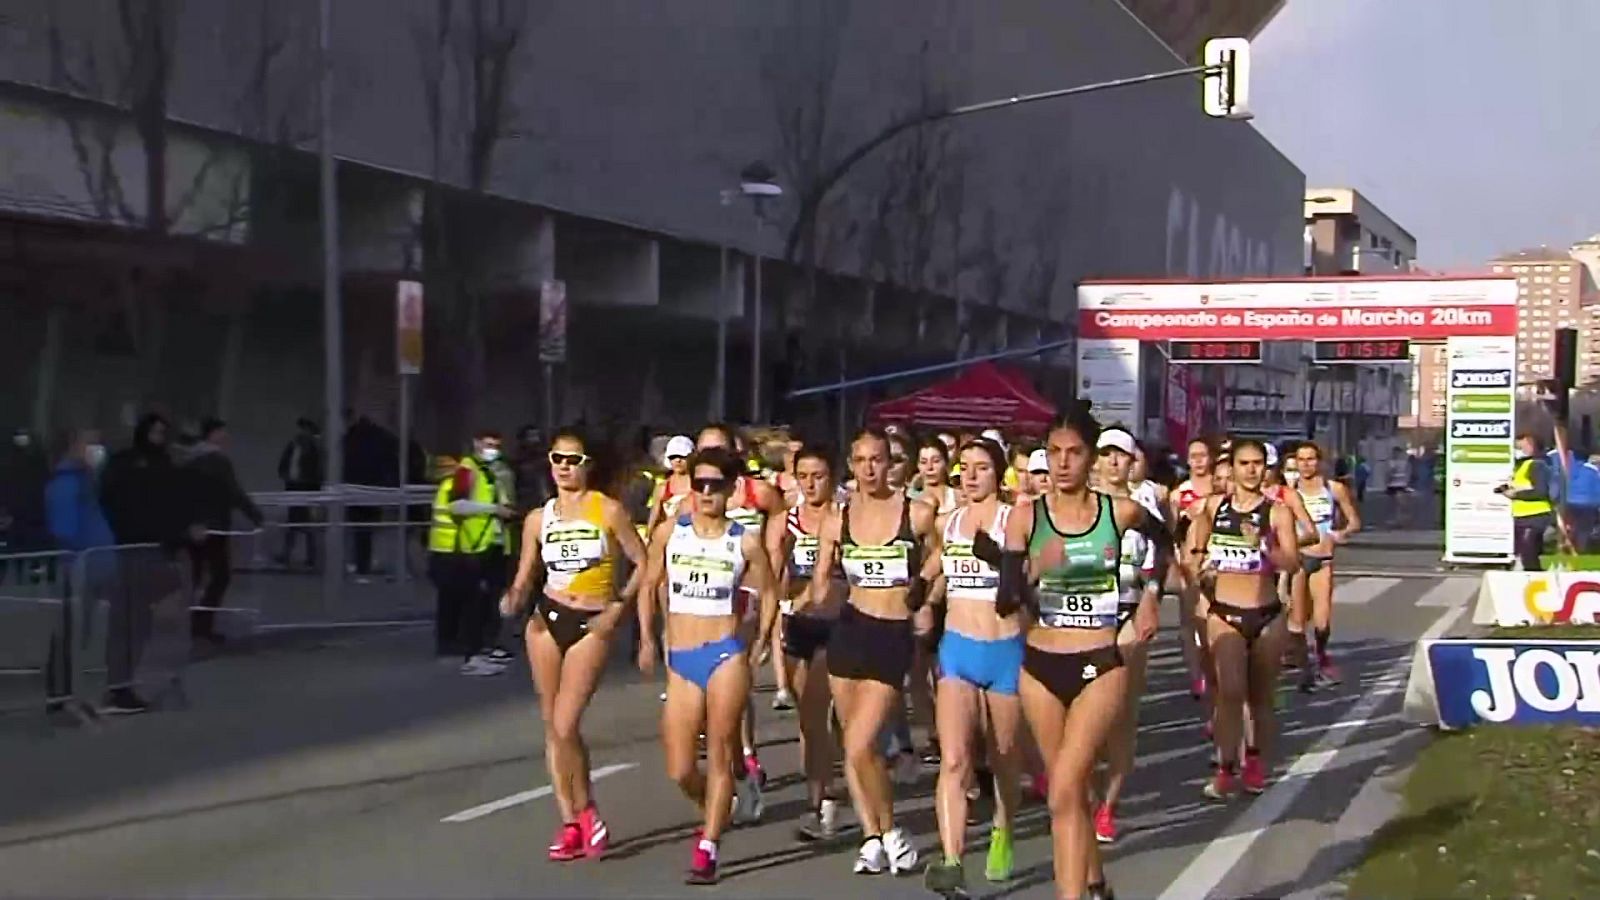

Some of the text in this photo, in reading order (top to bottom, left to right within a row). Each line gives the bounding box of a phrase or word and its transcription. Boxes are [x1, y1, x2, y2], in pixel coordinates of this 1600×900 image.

[1095, 307, 1492, 329] Campeonato de España de Marcha 20km
[560, 544, 580, 559] 69
[863, 561, 885, 575] 82
[953, 559, 981, 573] 160
[1066, 595, 1093, 612] 88
